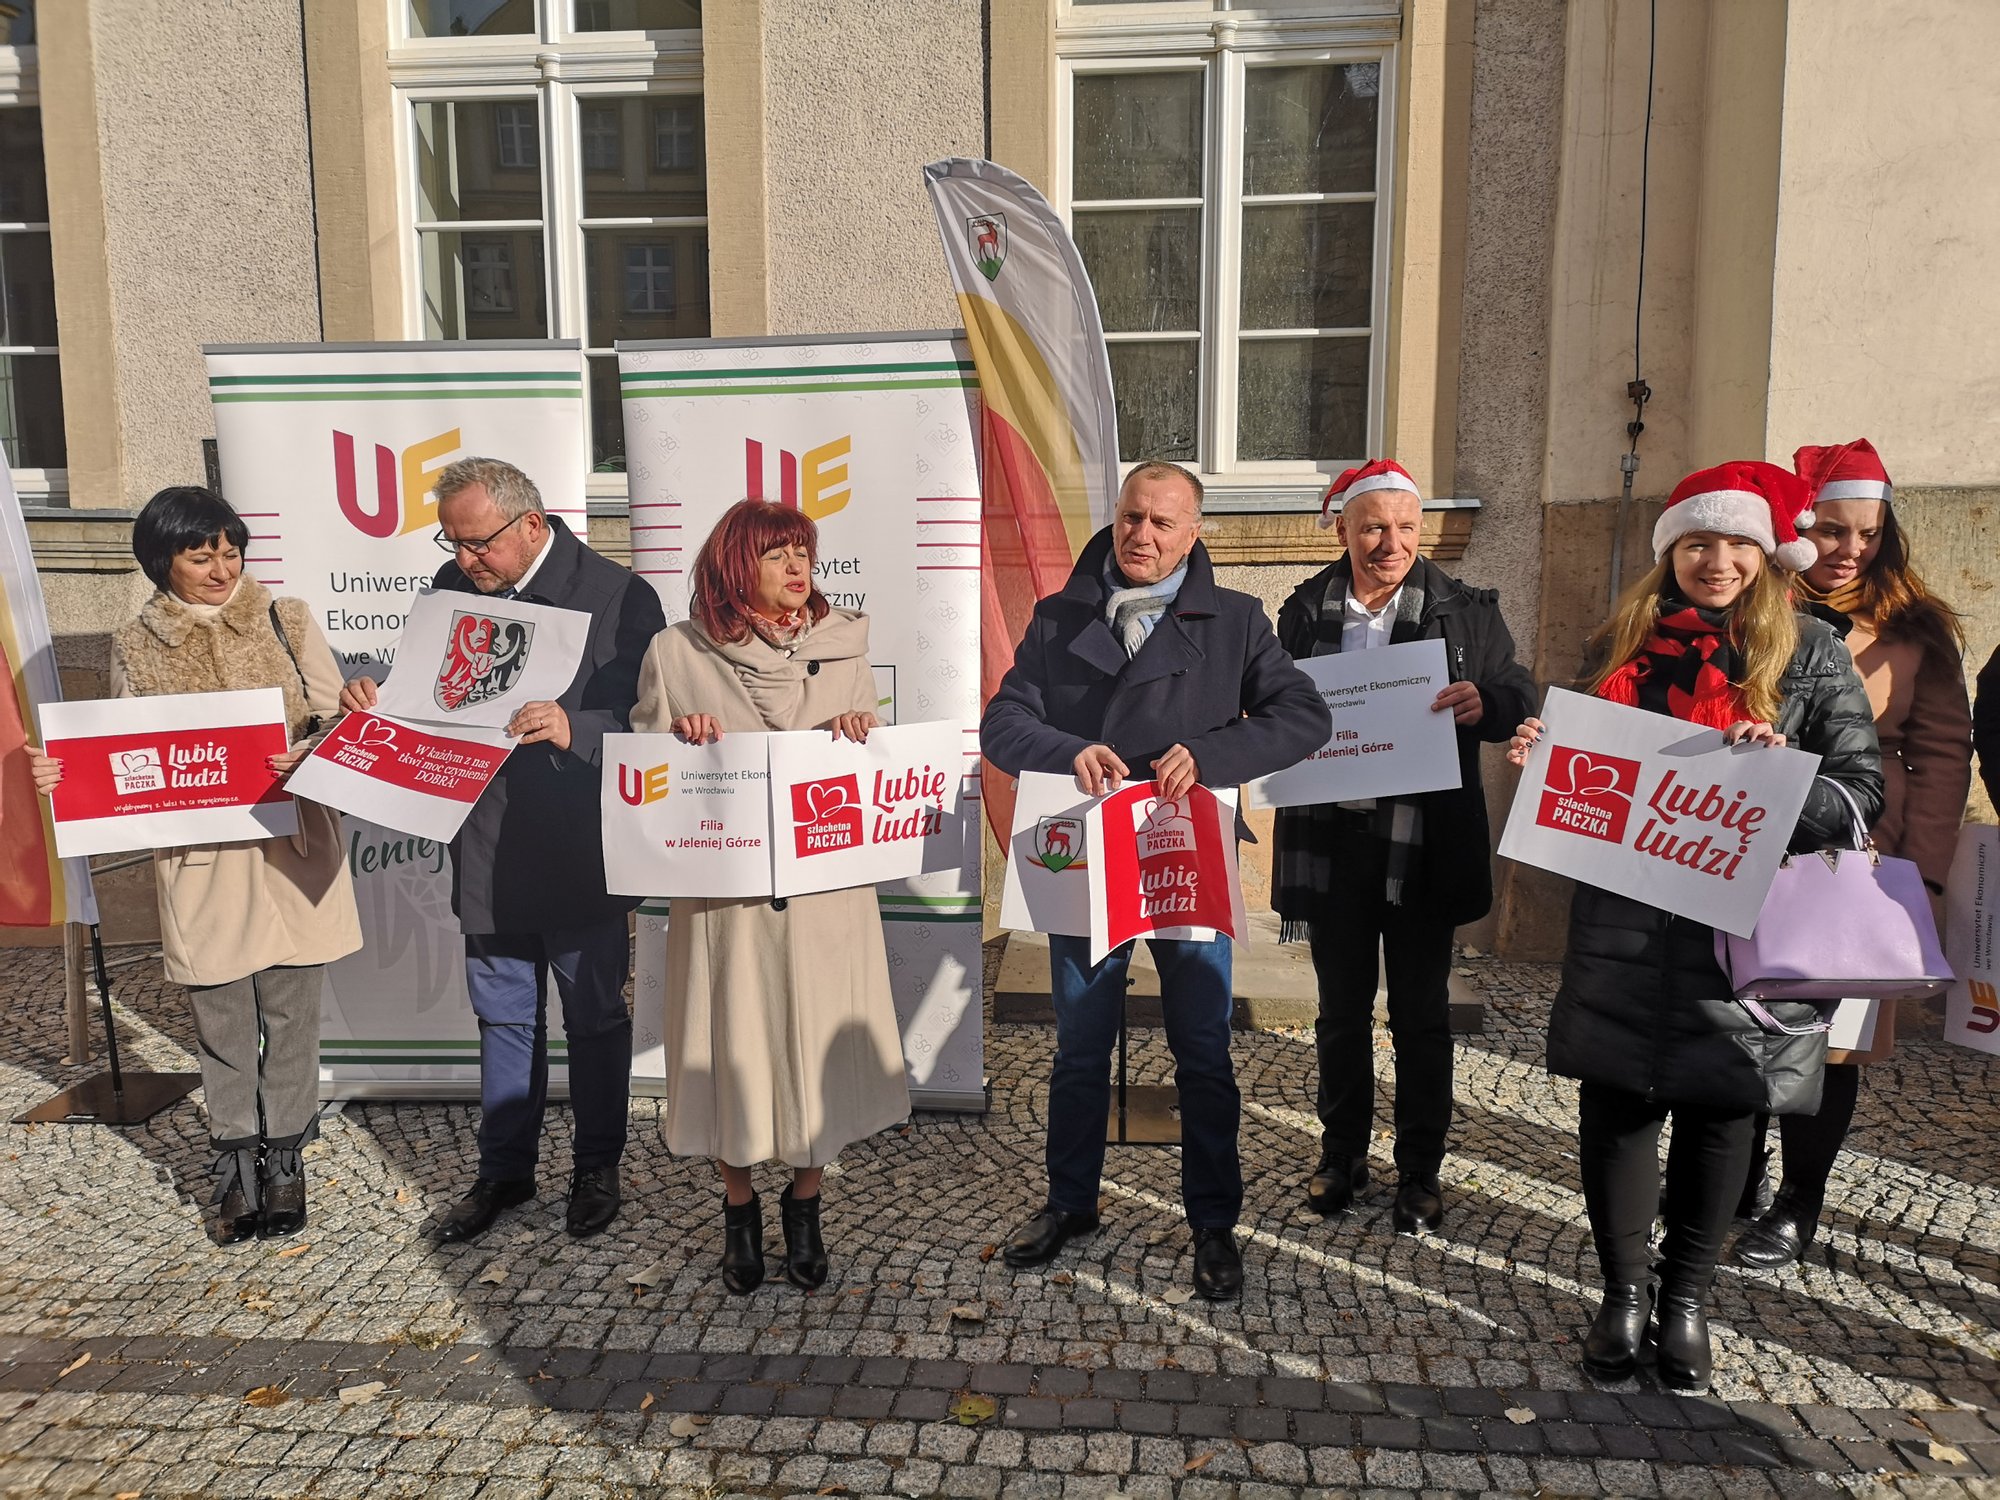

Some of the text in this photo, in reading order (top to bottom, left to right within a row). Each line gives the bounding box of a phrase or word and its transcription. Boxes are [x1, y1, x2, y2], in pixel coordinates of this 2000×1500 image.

[330, 572, 433, 593] Uniwers
[327, 610, 409, 631] Ekono
[342, 650, 371, 665] we
[1317, 675, 1431, 698] niwersytet Ekonomiczny
[1336, 730, 1358, 741] Filia
[168, 741, 228, 770] Lubię
[333, 750, 373, 771] PACZKA
[342, 744, 379, 761] szlachetna
[415, 743, 491, 769] W każdym z nas
[1318, 745, 1359, 759] Jeleniej
[1361, 742, 1394, 754] Górze
[171, 765, 228, 788] ludzi
[398, 752, 489, 781] tkwi moc czynienia
[681, 770, 771, 782] Uniwersytet Ekono
[125, 780, 156, 790] PACZKA
[414, 769, 459, 788] DOBRA!
[618, 762, 669, 807] UE
[872, 765, 946, 813] Lubię
[1557, 796, 1613, 821] szlachetna
[1647, 769, 1766, 844] Lubię
[700, 820, 724, 830] Filia
[807, 822, 851, 834] szlachetna
[872, 805, 943, 844] ludzi
[1552, 807, 1608, 836] PACZKA
[679, 837, 722, 850] Jeleniej
[726, 837, 761, 848] Górze
[807, 832, 851, 849] PACZKA
[1147, 829, 1185, 839] szlachetna
[1147, 838, 1186, 851] PACZKA
[1633, 818, 1748, 880] ludzi
[1138, 865, 1198, 897] Lubię
[1139, 892, 1197, 919] ludzi
[1974, 842, 1986, 969] Uniwersytet Ekonomiczny
